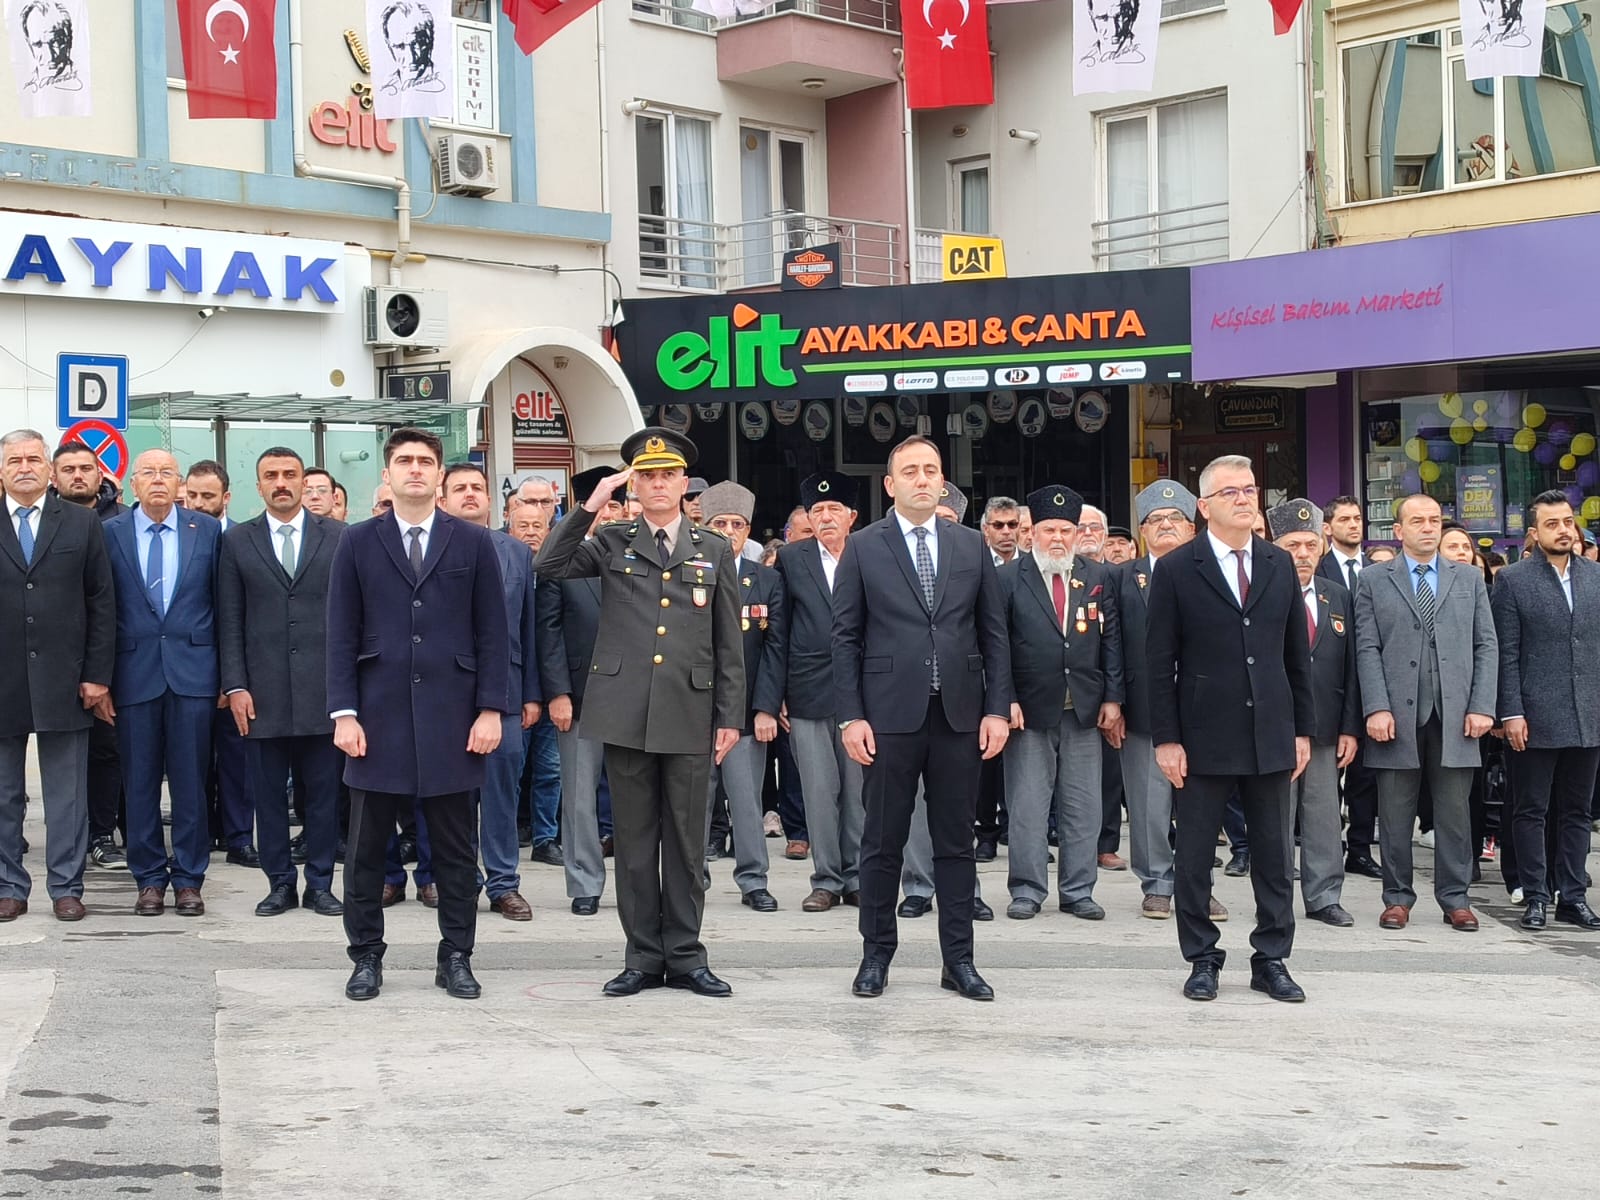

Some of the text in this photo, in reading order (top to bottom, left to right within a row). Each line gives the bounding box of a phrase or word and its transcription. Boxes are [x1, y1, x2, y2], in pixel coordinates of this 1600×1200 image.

[2, 234, 338, 303] AYNAK
[949, 246, 995, 275] CAT
[1211, 283, 1444, 334] Kişisel Bakım Marketi
[656, 302, 802, 391] elit
[1011, 309, 1147, 347] ÇANTA
[78, 371, 107, 412] D
[515, 390, 554, 420] elit
[1463, 489, 1493, 502] DEV
